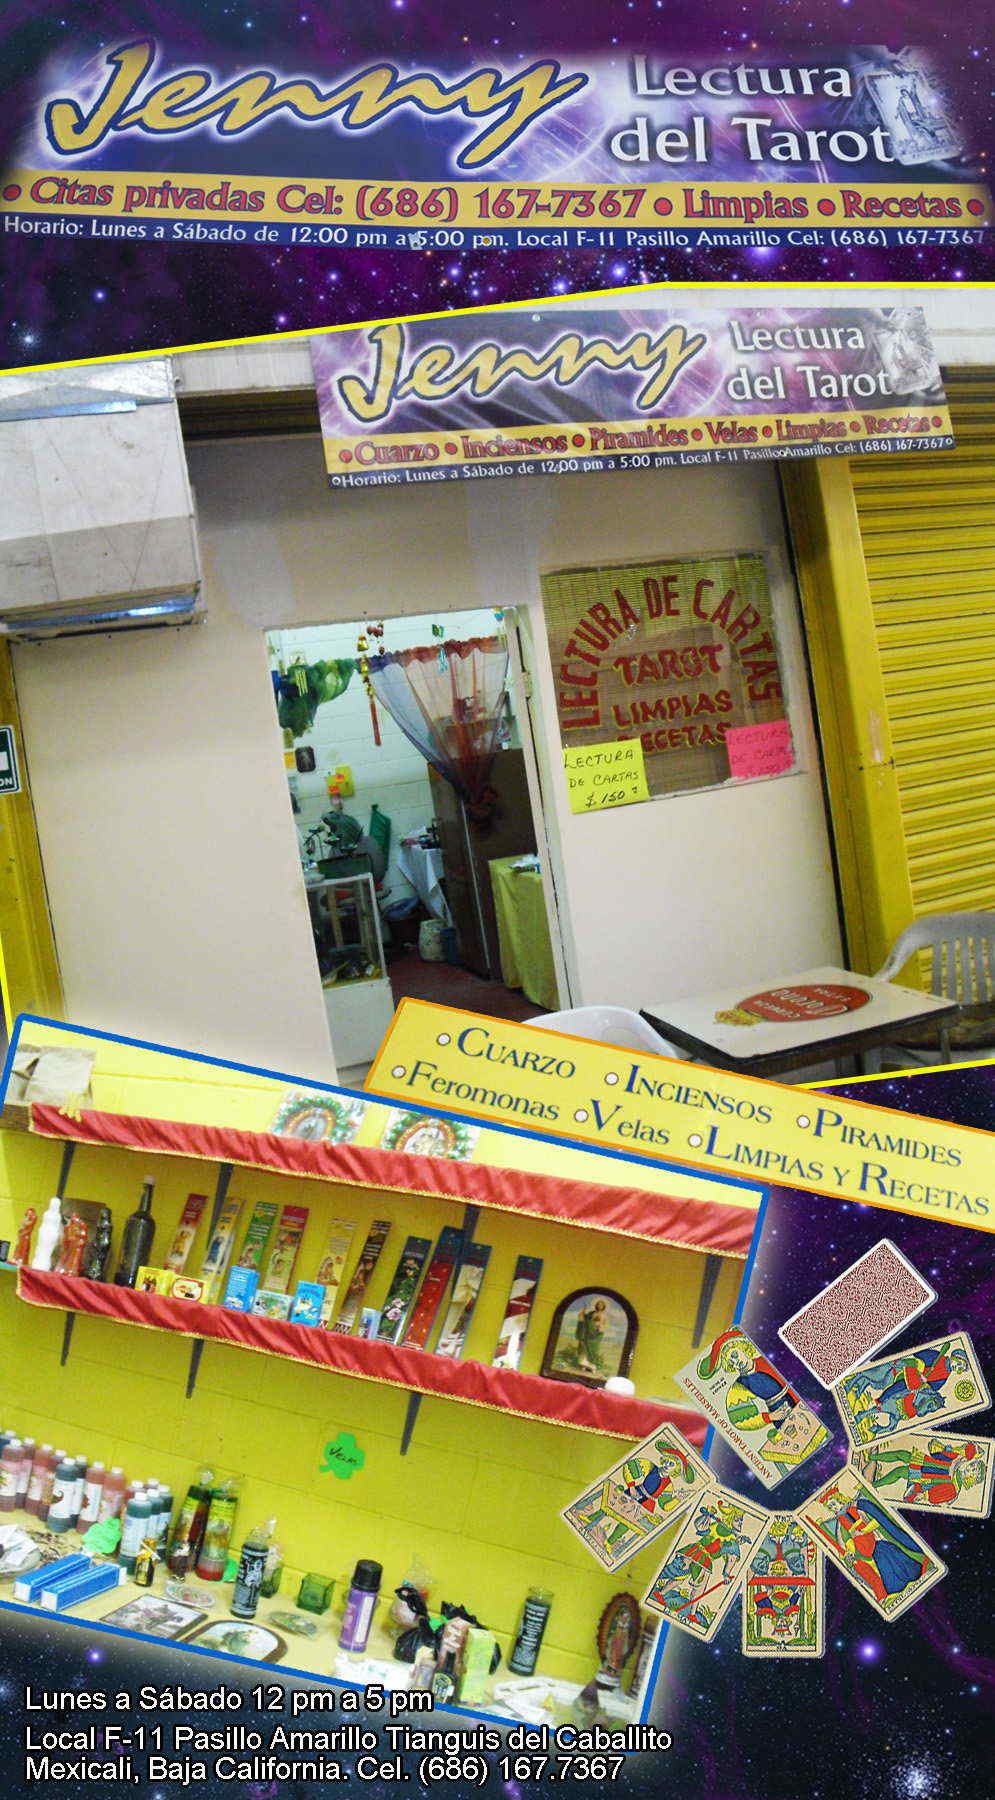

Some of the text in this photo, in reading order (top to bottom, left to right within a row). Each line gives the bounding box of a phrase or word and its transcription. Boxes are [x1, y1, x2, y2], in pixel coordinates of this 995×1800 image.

[631, 53, 853, 98] Lectura
[45, 37, 590, 169] Jenny
[611, 116, 895, 163] del Tarot
[30, 177, 963, 224] Citas privadas Cel: (686) 167-7367 Limpias Recetas
[4, 216, 84, 236] Horario:
[91, 219, 147, 239] Lunes
[153, 226, 165, 239] a
[172, 220, 247, 242] Sábado
[254, 224, 280, 243] de
[290, 226, 349, 246] 12:00
[355, 231, 388, 248] pm
[396, 231, 409, 247] a
[417, 230, 466, 248] 5:00
[517, 230, 569, 247] Local
[575, 230, 615, 247] F-11
[626, 230, 689, 247] Pasillo
[696, 230, 784, 247] Amarillo
[788, 229, 825, 246] Cel:
[831, 228, 887, 247] (686)
[896, 229, 985, 246] 167-7367
[728, 320, 866, 352] Lectura
[337, 323, 707, 424] Jenny
[727, 365, 890, 400] del Tarot
[353, 412, 930, 466] Cuarzo Inciensos Piramides Velas Limpias Recetas
[341, 473, 401, 489] Horario:
[406, 468, 446, 483] Lunes
[450, 470, 459, 480] a
[463, 463, 514, 479] Sábado
[518, 462, 535, 475] de
[542, 458, 578, 474] 12:00
[582, 458, 604, 472] pm
[607, 459, 616, 469] a
[620, 454, 651, 469] 5:00
[655, 454, 678, 468] pm.
[680, 451, 712, 466] Local
[715, 449, 739, 463] F-11
[743, 446, 781, 461] Pasillo
[785, 444, 833, 458] Amarillo
[835, 442, 857, 455] Cel:
[859, 438, 892, 454] (686)
[559, 574, 783, 730] LECTURA DE CARTAS
[612, 643, 724, 686] TAROT
[612, 689, 733, 728] LIMPIAS
[564, 748, 634, 769] LECTURA
[617, 721, 731, 753] ECETAS
[592, 770, 640, 786] CARTAS
